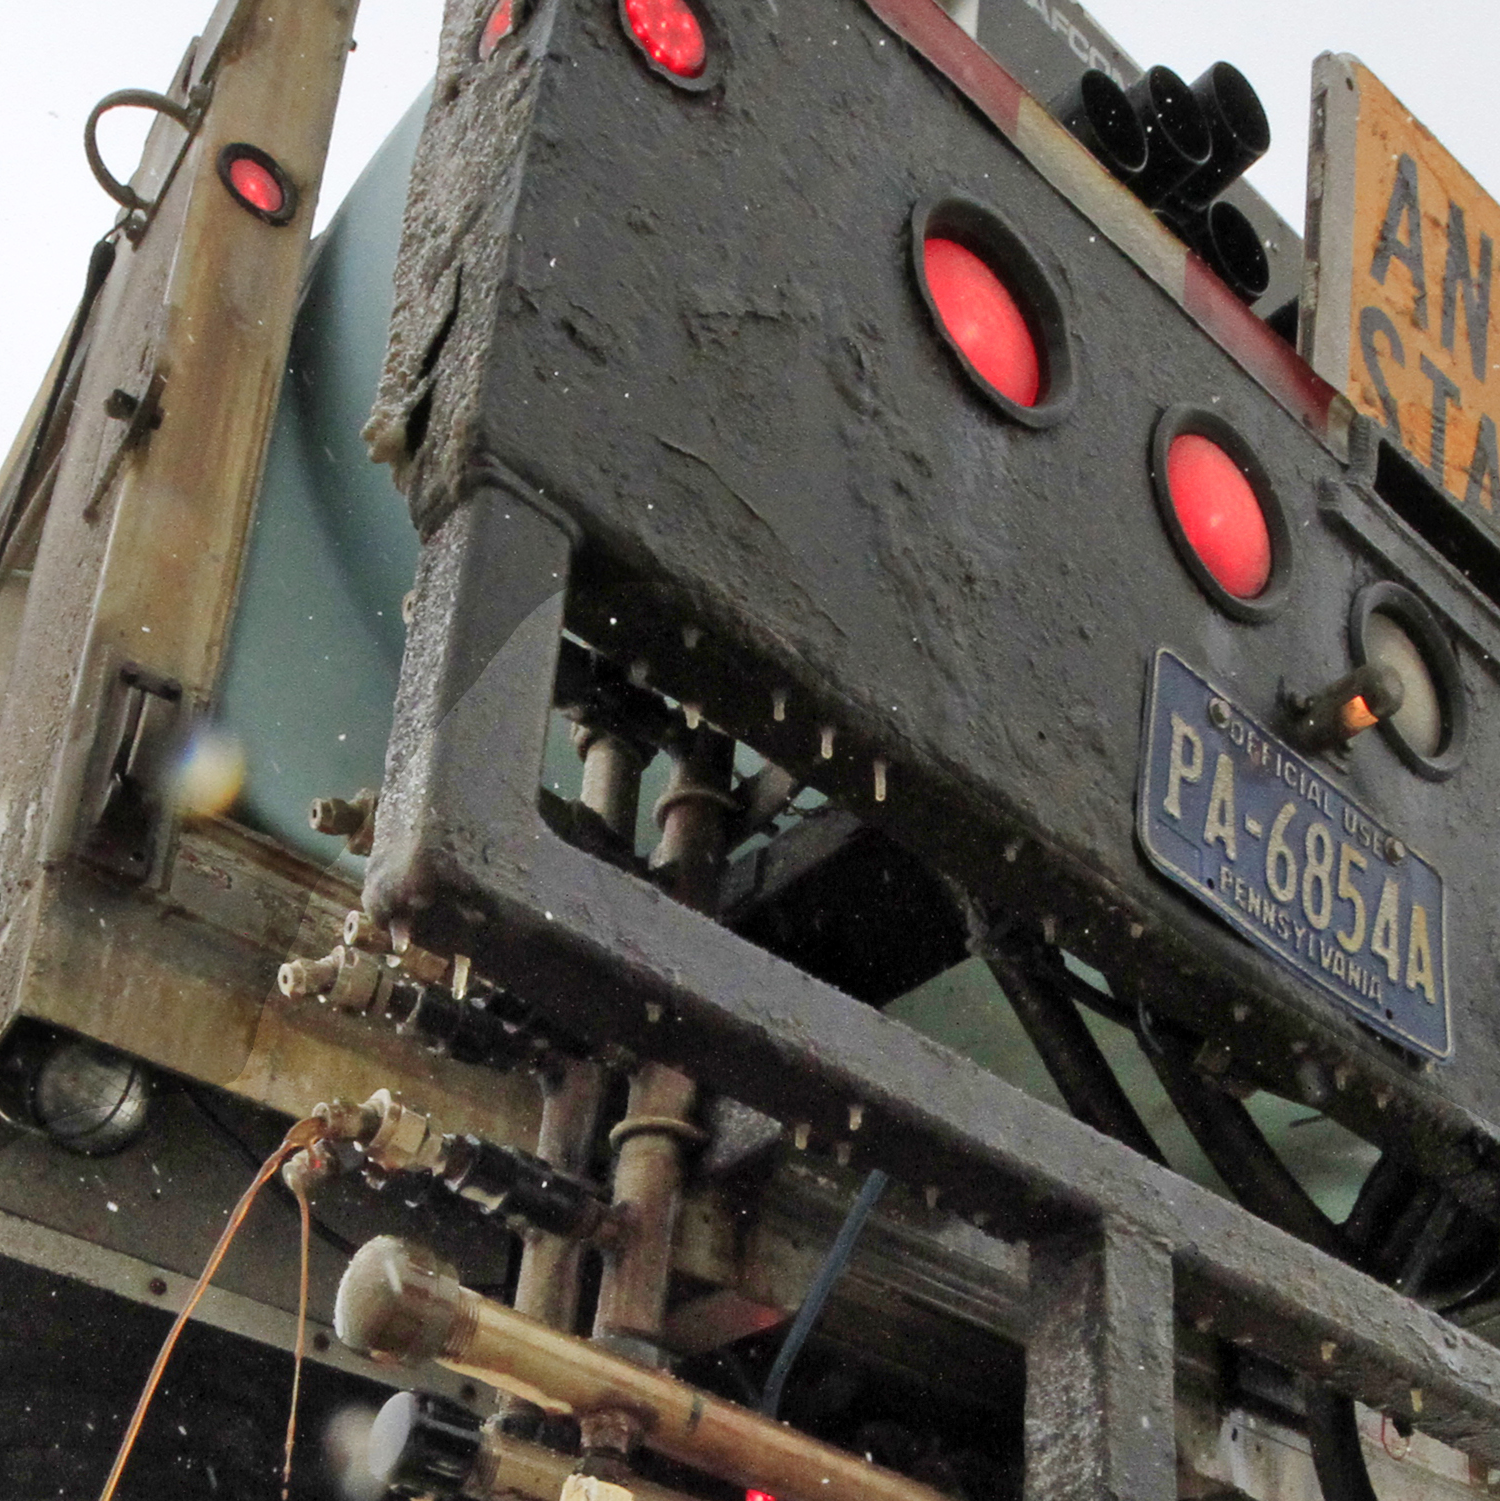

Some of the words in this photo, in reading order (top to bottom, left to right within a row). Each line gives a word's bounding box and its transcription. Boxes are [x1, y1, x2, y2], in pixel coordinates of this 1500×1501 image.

[1163, 712, 1436, 1004] PA-6854A
[1228, 716, 1334, 820] OFFICIAL
[1344, 810, 1384, 857] USE
[1219, 865, 1383, 1010] PENNSYLVANIA
